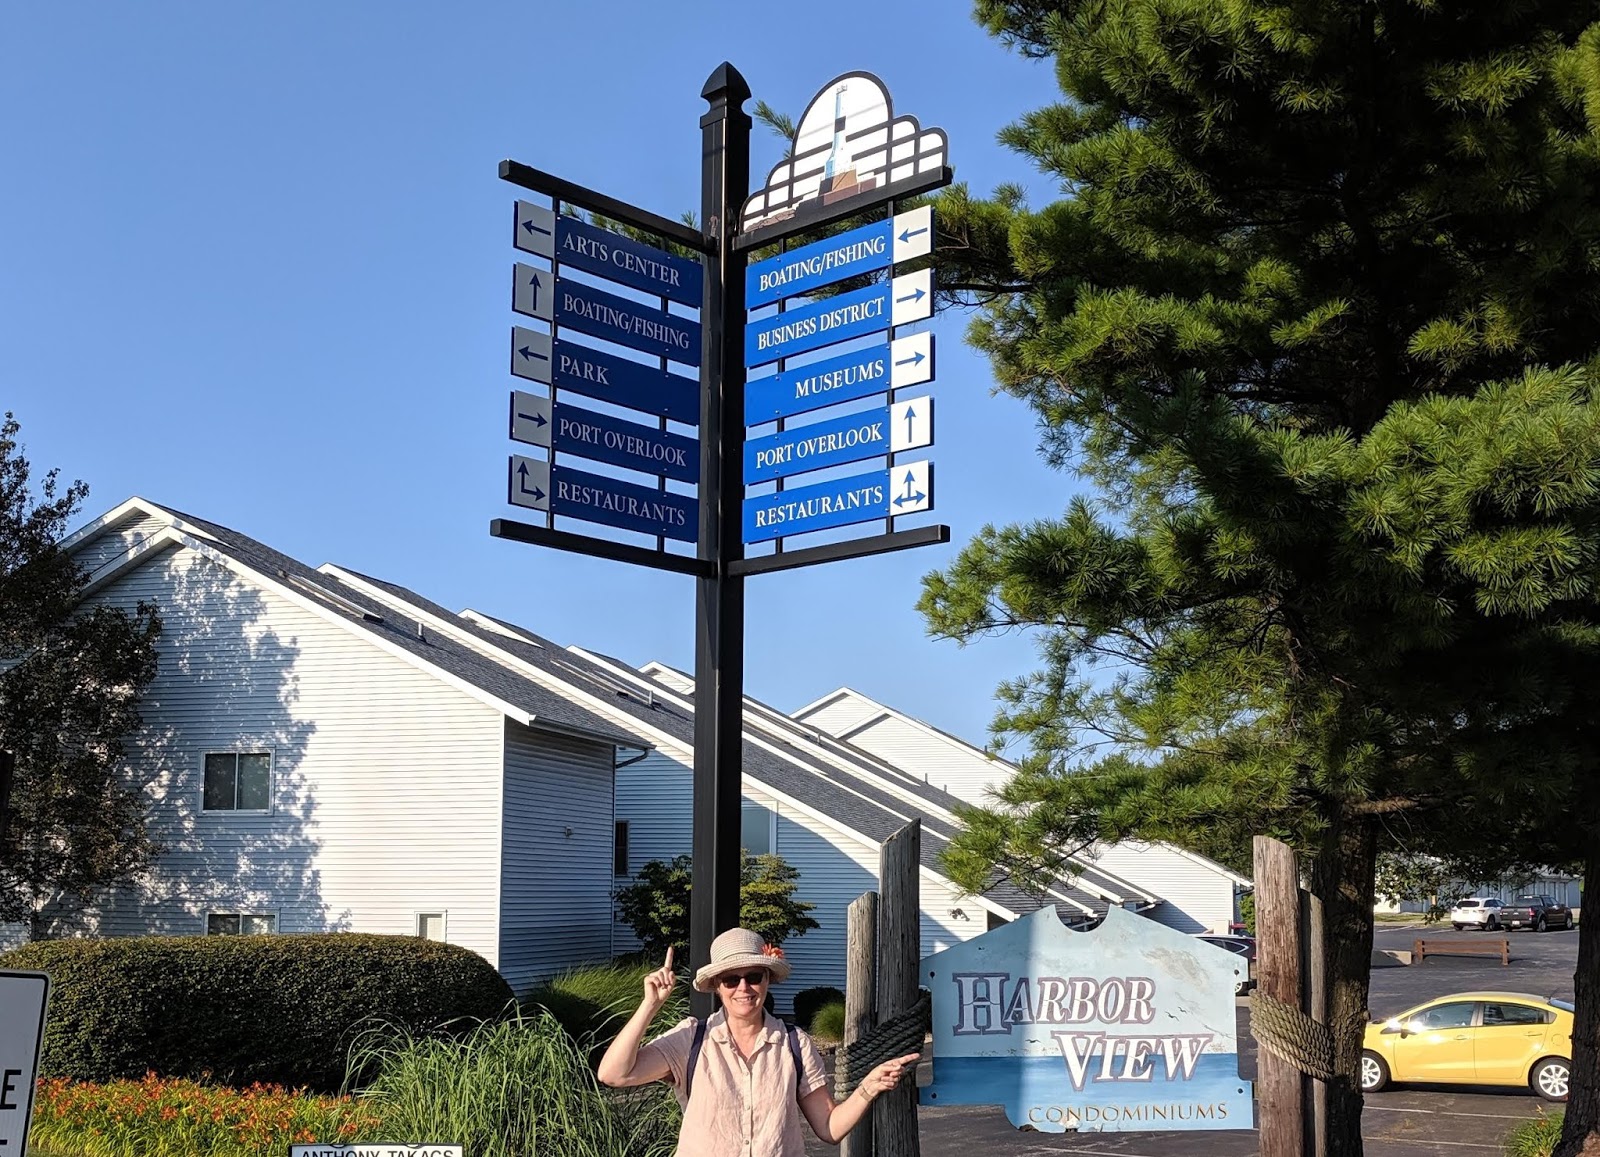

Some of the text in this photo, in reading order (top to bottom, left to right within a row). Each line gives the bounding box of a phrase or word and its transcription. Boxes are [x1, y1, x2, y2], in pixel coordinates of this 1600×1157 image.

[563, 233, 680, 287] ARTS CENTER
[759, 235, 886, 292] BOATING/FISHING
[563, 293, 690, 349] BOATING/FISHING
[758, 296, 885, 351] BUSINESS DISTRICT
[559, 354, 610, 386] PARK
[795, 359, 884, 399] MUSEUMS
[559, 418, 687, 467] PORT OVERLOOK
[756, 422, 883, 469] PORT OVERLOOK
[557, 480, 685, 526] RESTAURANTS
[755, 485, 883, 528] RESTAURANTS
[952, 972, 1157, 1036] HARBOR
[1050, 1030, 1214, 1092] VIEW
[1028, 1102, 1229, 1123] CONDOMINIUMS
